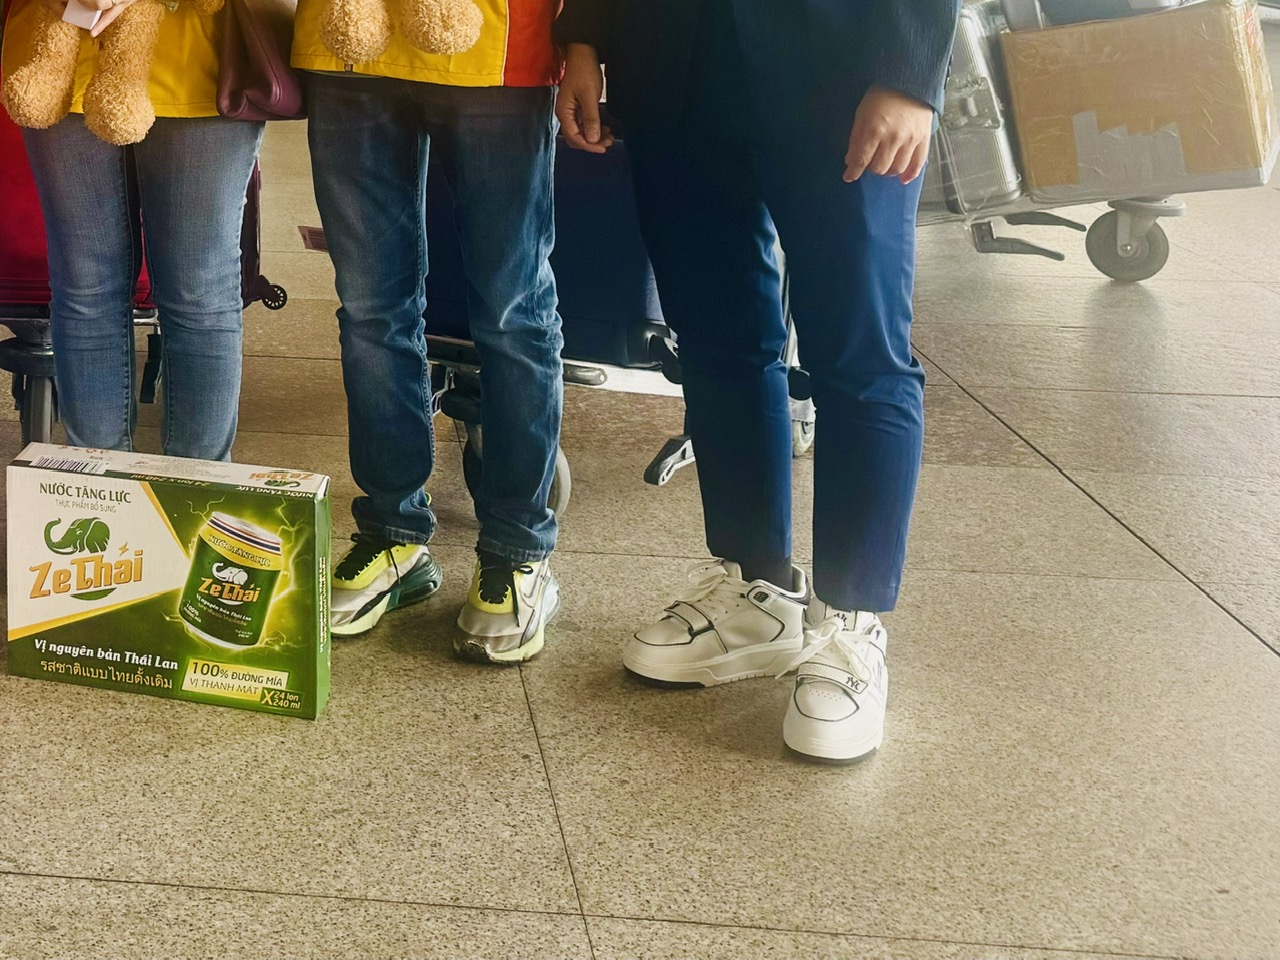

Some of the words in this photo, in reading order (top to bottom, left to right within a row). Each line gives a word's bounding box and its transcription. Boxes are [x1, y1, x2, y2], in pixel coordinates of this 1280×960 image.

[39, 482, 73, 497] NƯỚC
[75, 485, 106, 501] TĂNG
[109, 489, 132, 505] LỰC
[34, 638, 46, 653] Vị
[48, 642, 94, 659] nguyên
[97, 647, 121, 662] bản
[124, 651, 152, 666] Thái
[155, 656, 179, 671] Lan
[40, 659, 173, 690] รสชาติแบบไทยดั้งเดิม
[192, 661, 229, 679] 100%
[231, 669, 264, 684] ĐƯỜNG
[265, 674, 283, 687] MÍA
[189, 677, 200, 689] VỊ
[201, 678, 235, 693] THANH
[236, 682, 259, 696] MÁT
[274, 690, 285, 699] 24
[286, 693, 299, 702] lon
[273, 698, 289, 707] 240
[290, 700, 301, 709] ml
